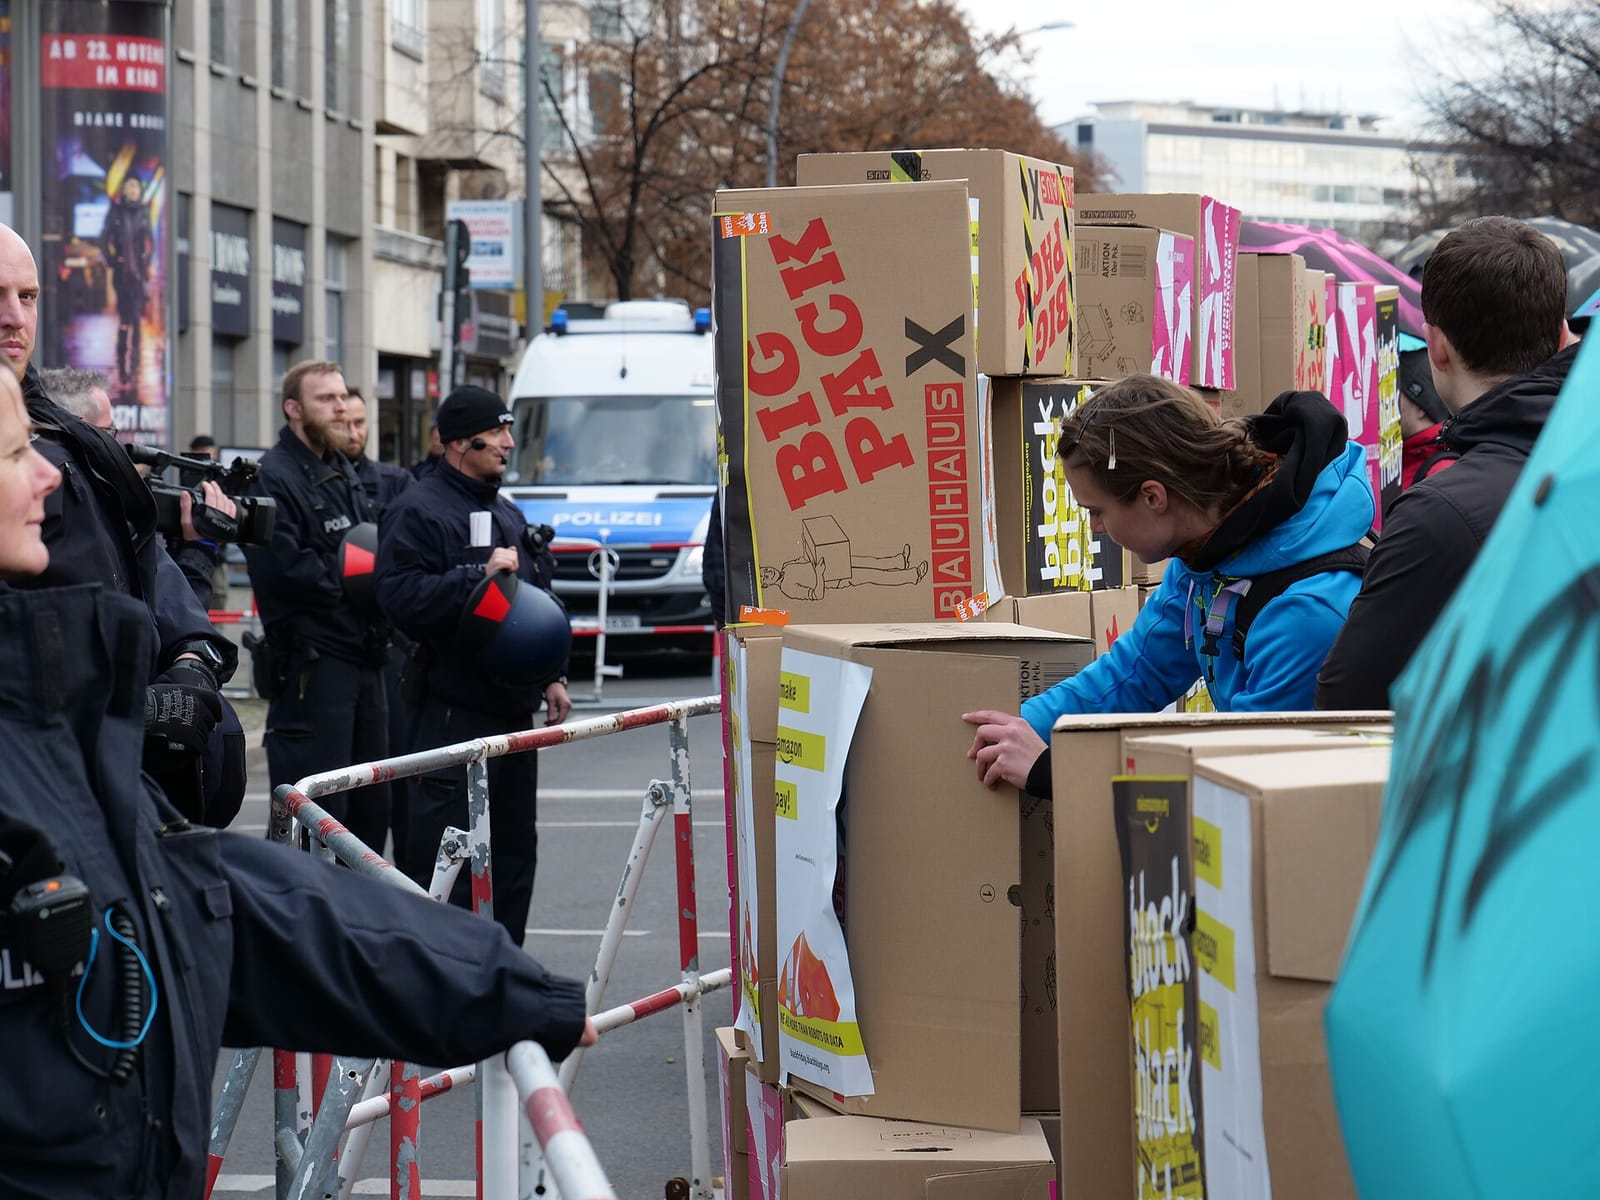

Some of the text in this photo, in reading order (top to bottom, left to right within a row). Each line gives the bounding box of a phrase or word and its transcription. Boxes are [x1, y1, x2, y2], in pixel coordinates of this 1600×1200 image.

[50, 40, 76, 59] AB
[96, 65, 158, 88] IM KINO
[1015, 217, 1065, 330] PACK
[1102, 243, 1111, 278] AKTION
[768, 217, 914, 485] PACK
[1036, 276, 1068, 367] BIG
[747, 332, 848, 511] BIG
[905, 313, 969, 616] BAUHAUS X
[552, 511, 662, 527] POLIZEI
[1033, 396, 1061, 582] block
[1020, 660, 1030, 703] KTION
[776, 737, 803, 758] amazon
[1130, 856, 1191, 998] block
[829, 1034, 845, 1048] DATA
[1136, 1008, 1196, 1142] black
